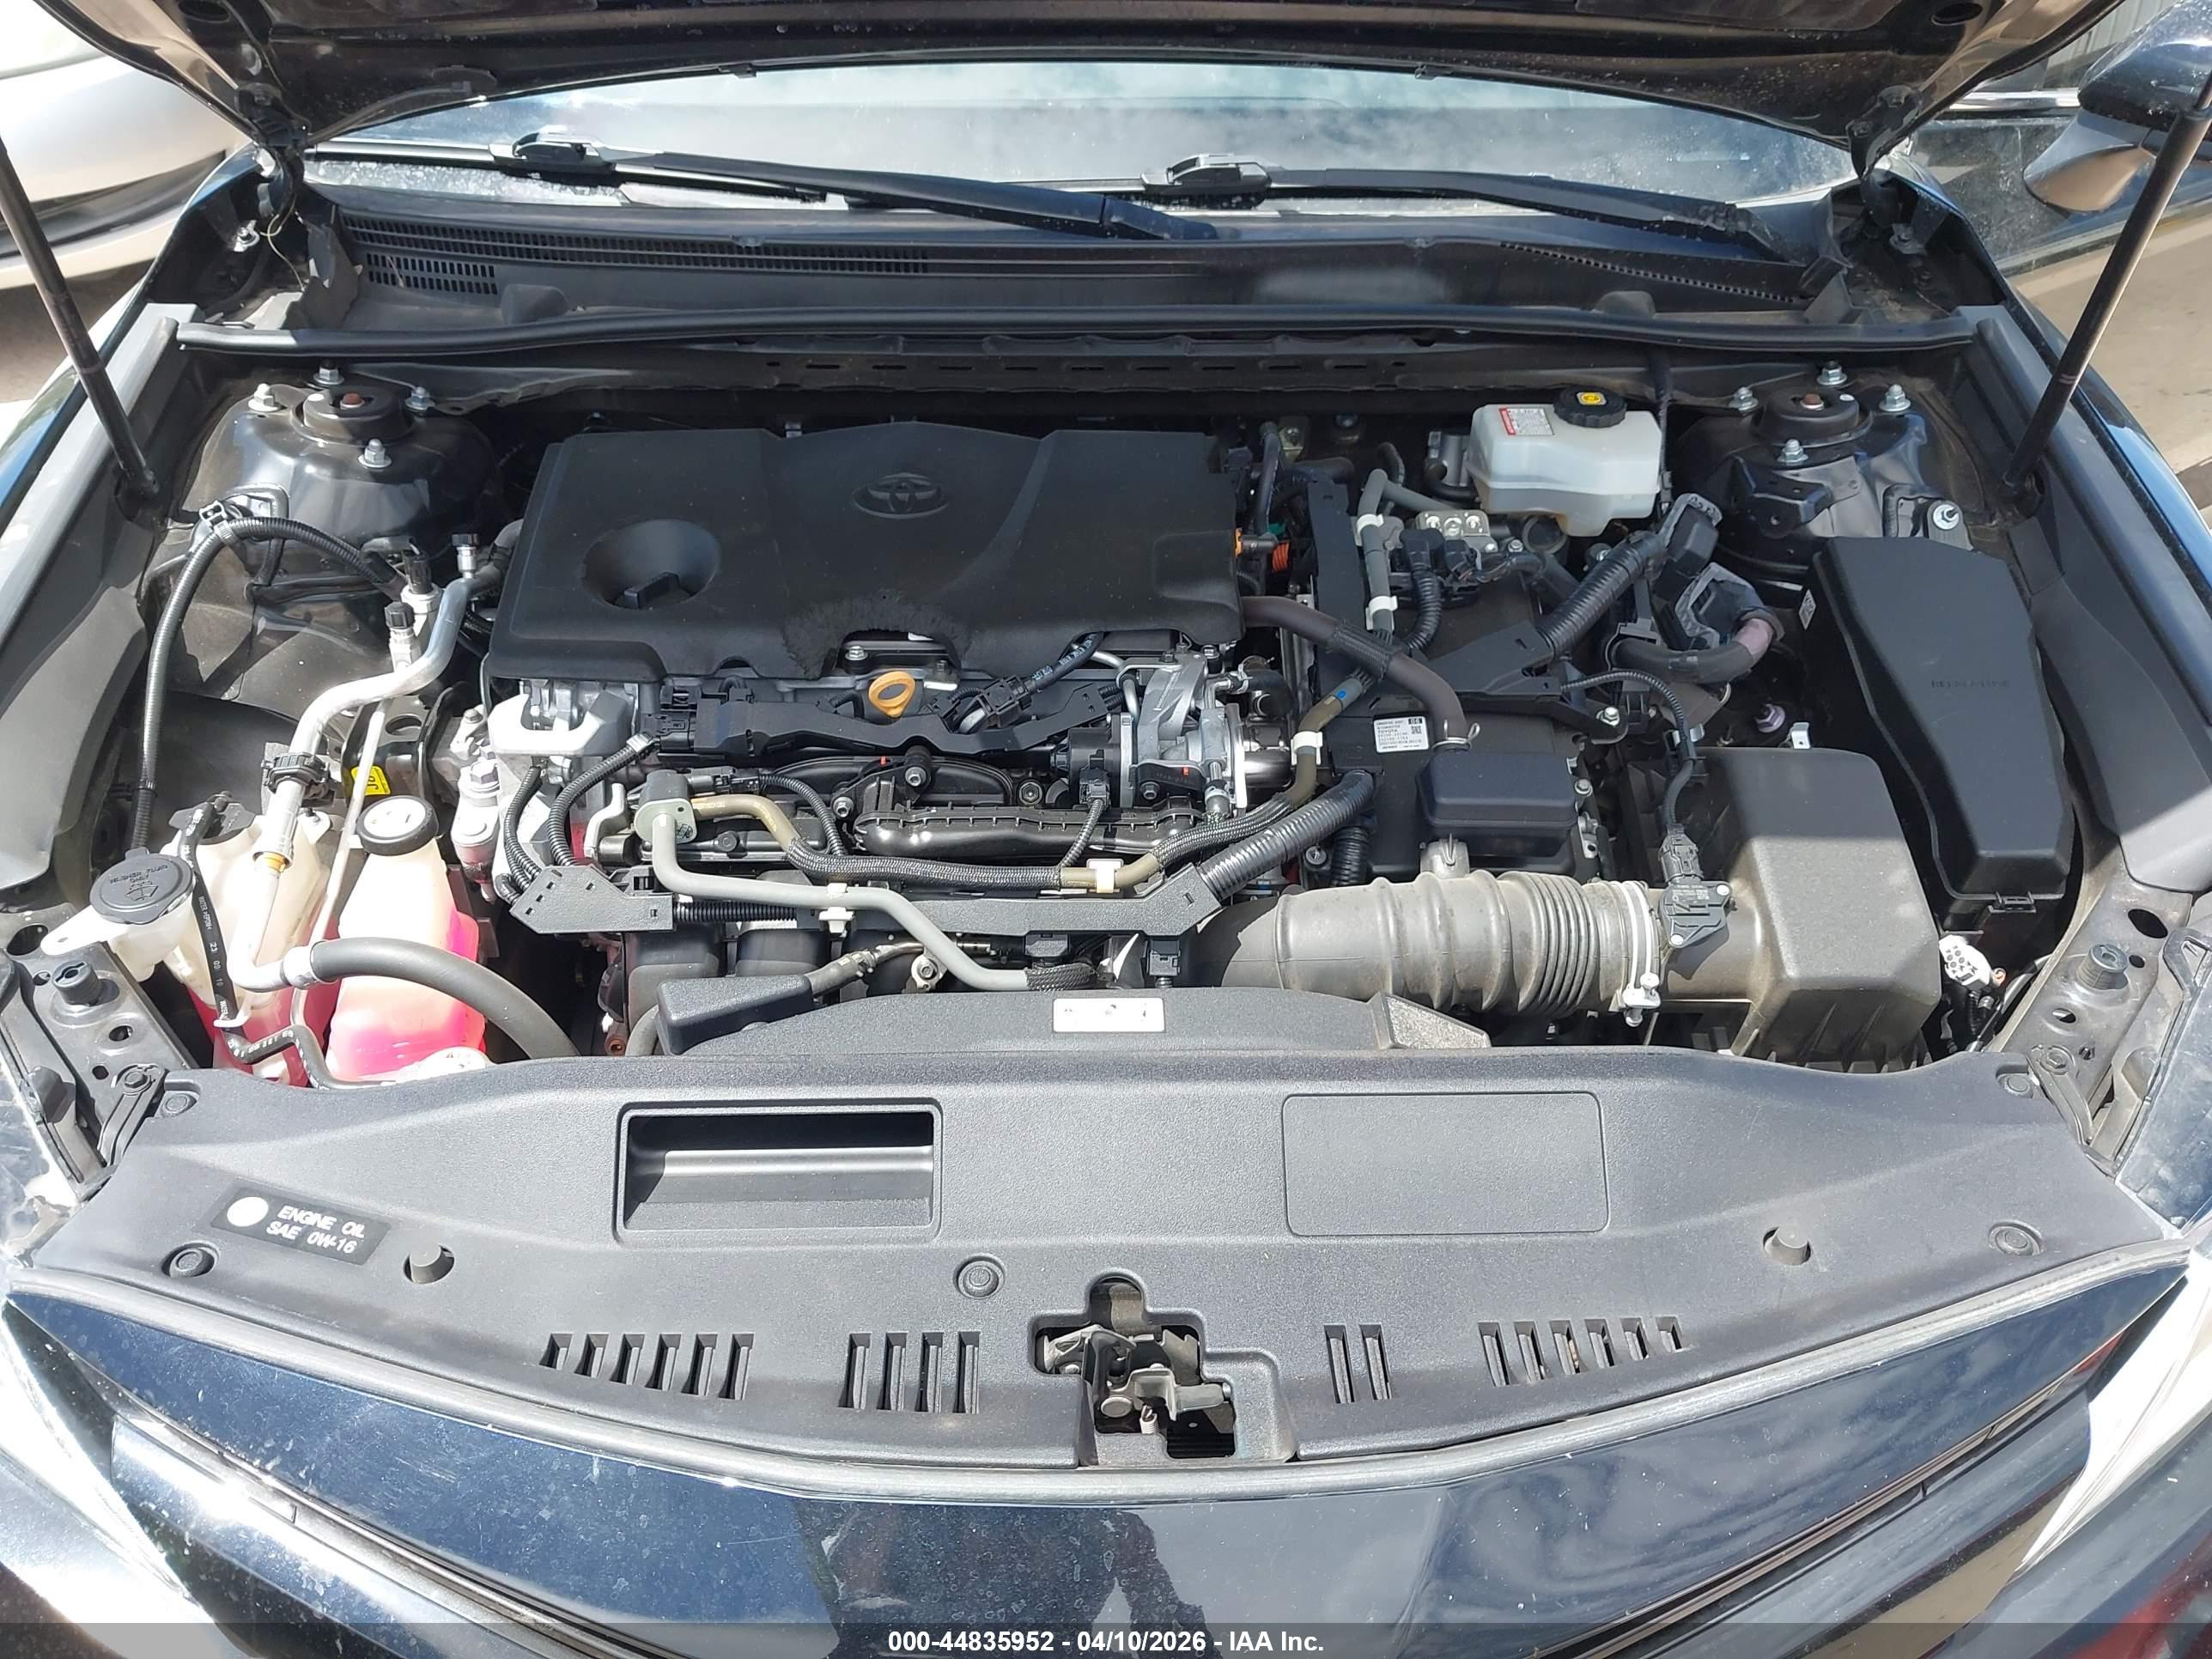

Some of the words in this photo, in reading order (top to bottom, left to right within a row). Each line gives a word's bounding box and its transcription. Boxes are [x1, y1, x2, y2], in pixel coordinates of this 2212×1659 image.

[266, 1220, 301, 1240] SAE
[307, 1231, 357, 1254] 0W-16
[277, 1205, 337, 1231] ENGINE
[342, 1221, 366, 1238] OIL
